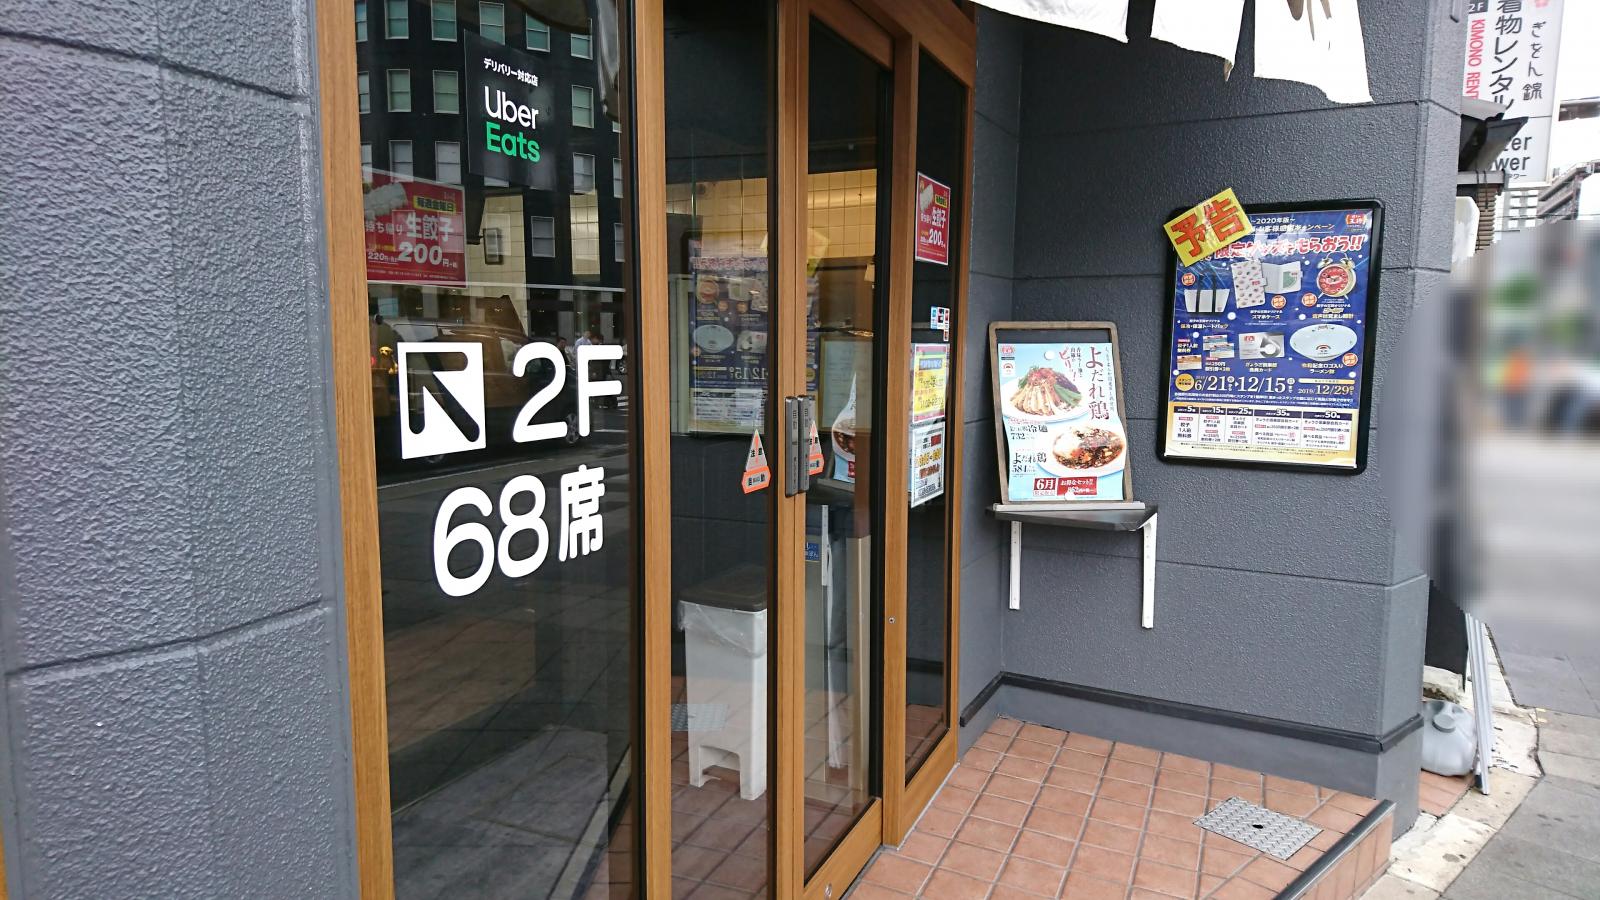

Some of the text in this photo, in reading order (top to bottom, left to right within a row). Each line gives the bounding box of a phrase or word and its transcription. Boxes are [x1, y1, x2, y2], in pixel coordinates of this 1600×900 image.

[1468, 19, 1485, 67] KIMONO
[483, 57, 539, 87] デリバリー対応店
[484, 86, 539, 129] Uber
[486, 121, 541, 162] Eats
[1504, 136, 1532, 151] er
[406, 211, 455, 242] 生餃子
[1171, 197, 1246, 257] 予告
[513, 342, 623, 443] 2F
[1086, 347, 1109, 420] よだれ鶏
[1237, 376, 1286, 393] 12/15
[1036, 478, 1054, 490] 6月
[434, 464, 605, 597] 68席
